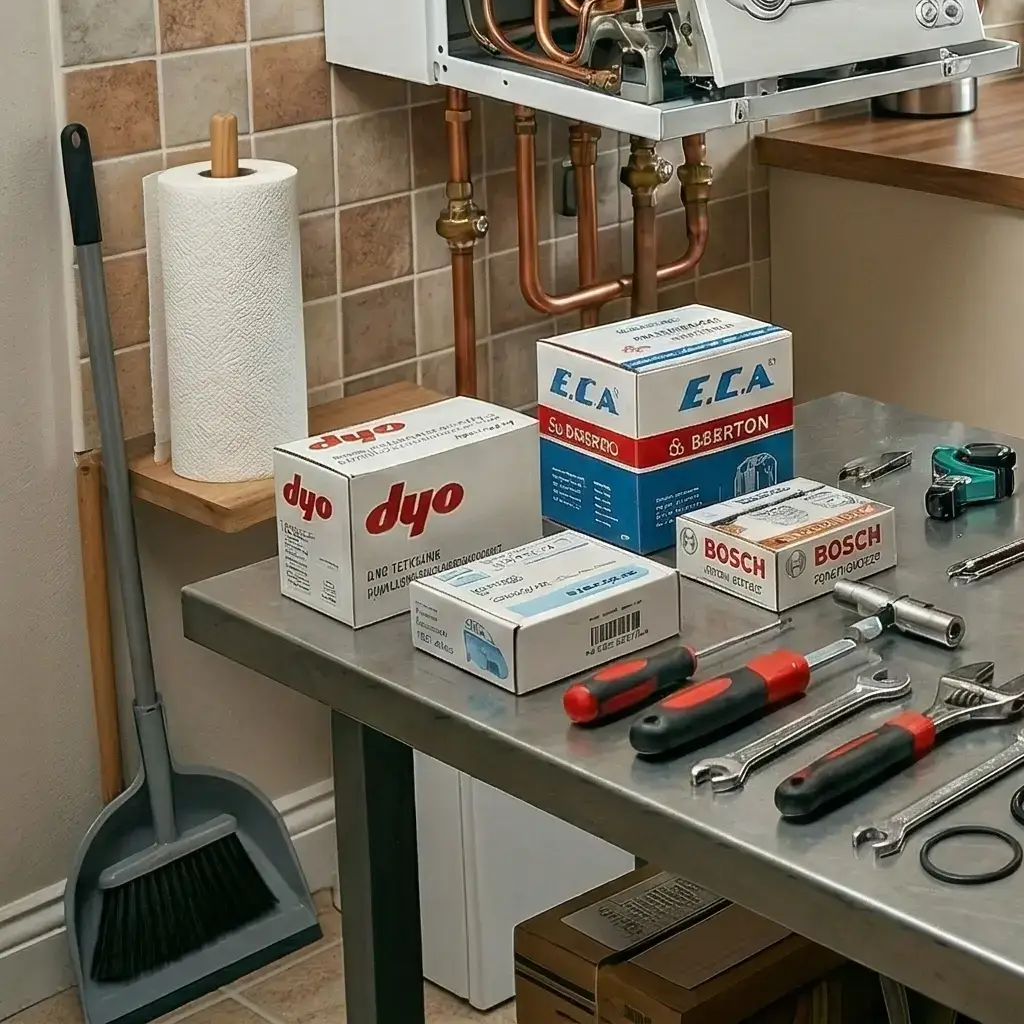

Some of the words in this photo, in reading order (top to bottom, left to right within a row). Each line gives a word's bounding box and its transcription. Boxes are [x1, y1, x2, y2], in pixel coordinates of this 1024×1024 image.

[308, 421, 406, 451] dyo
[283, 474, 333, 521] dyo
[365, 481, 465, 538] dyo
[704, 537, 766, 580] BOSCH
[814, 524, 881, 567] BOSCH
